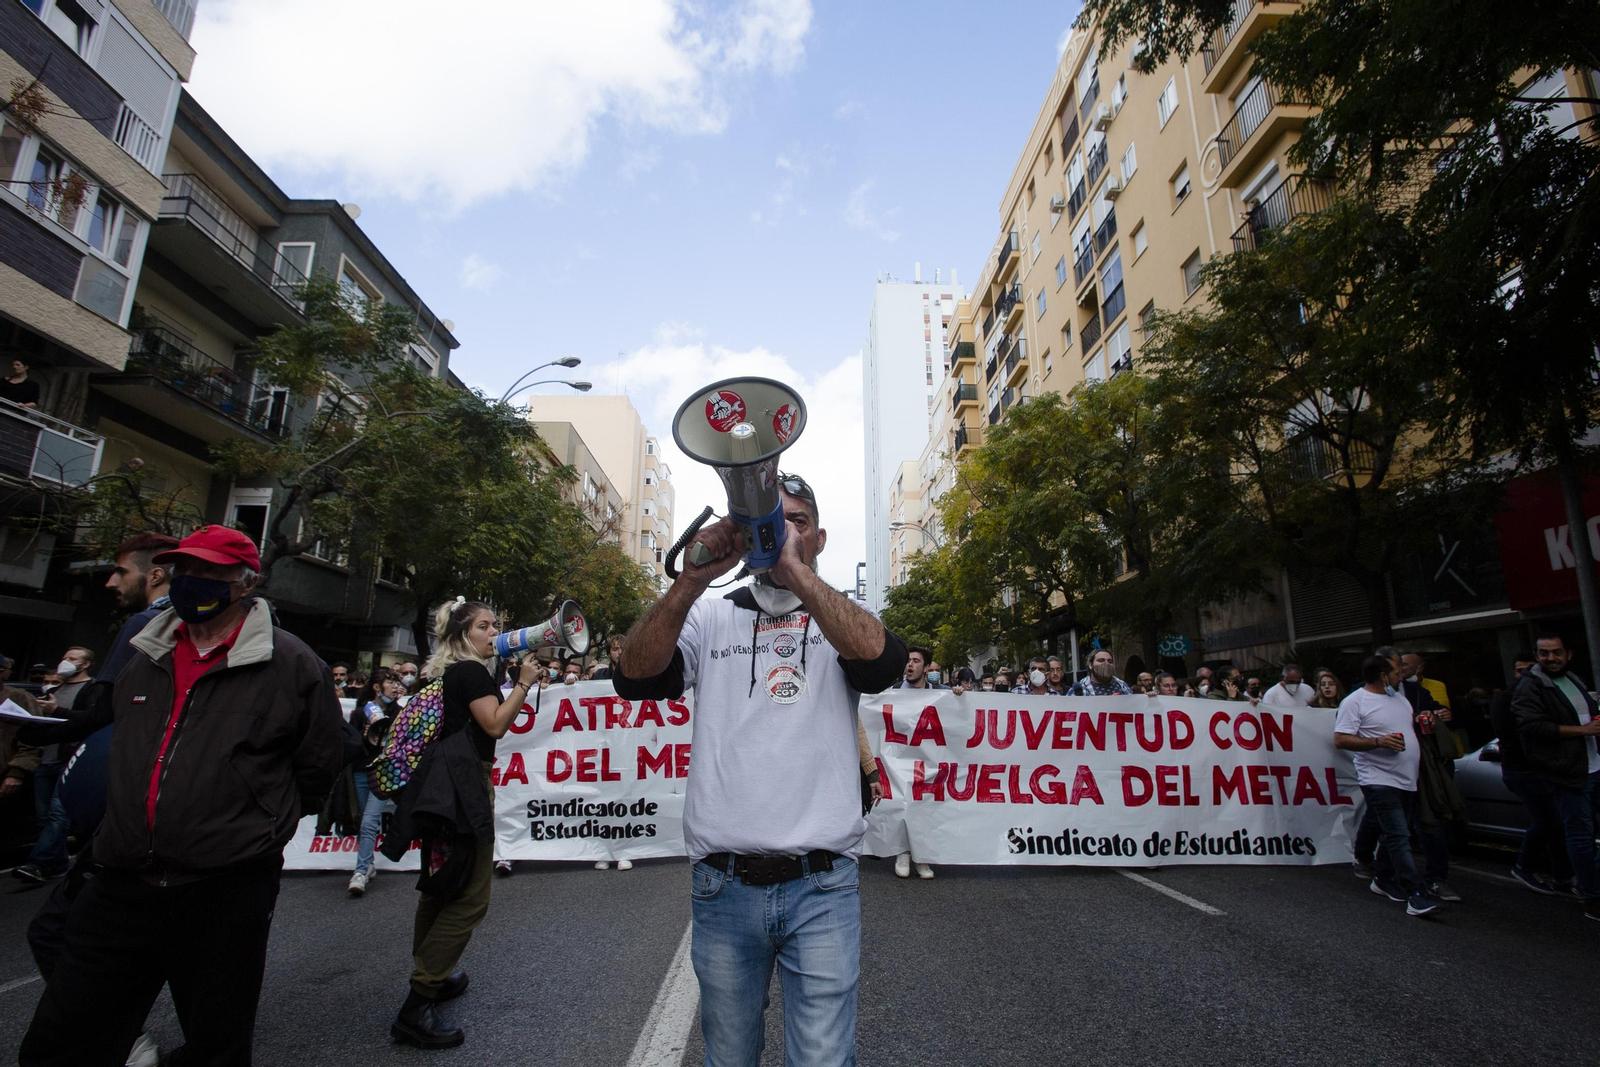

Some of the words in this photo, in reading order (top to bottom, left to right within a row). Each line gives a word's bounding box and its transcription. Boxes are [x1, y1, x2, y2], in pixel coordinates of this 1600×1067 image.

[711, 649, 719, 659] NO
[721, 645, 731, 659] NOS
[777, 646, 793, 654] CGT
[552, 696, 691, 733] ATRAS
[882, 703, 947, 746] LA
[966, 708, 1195, 752] JUVENTUD
[1209, 711, 1293, 752] CON
[546, 748, 621, 783] DEL
[912, 759, 1104, 805] HUELGA
[1121, 764, 1200, 807] DEL
[1212, 764, 1354, 806] METAL
[527, 797, 628, 818] Sindicato
[630, 797, 658, 817] de
[530, 819, 657, 841] Estudiantes
[1007, 827, 1138, 857] Sindicato
[1143, 830, 1171, 858] de
[1173, 828, 1317, 857] Estudiantes
